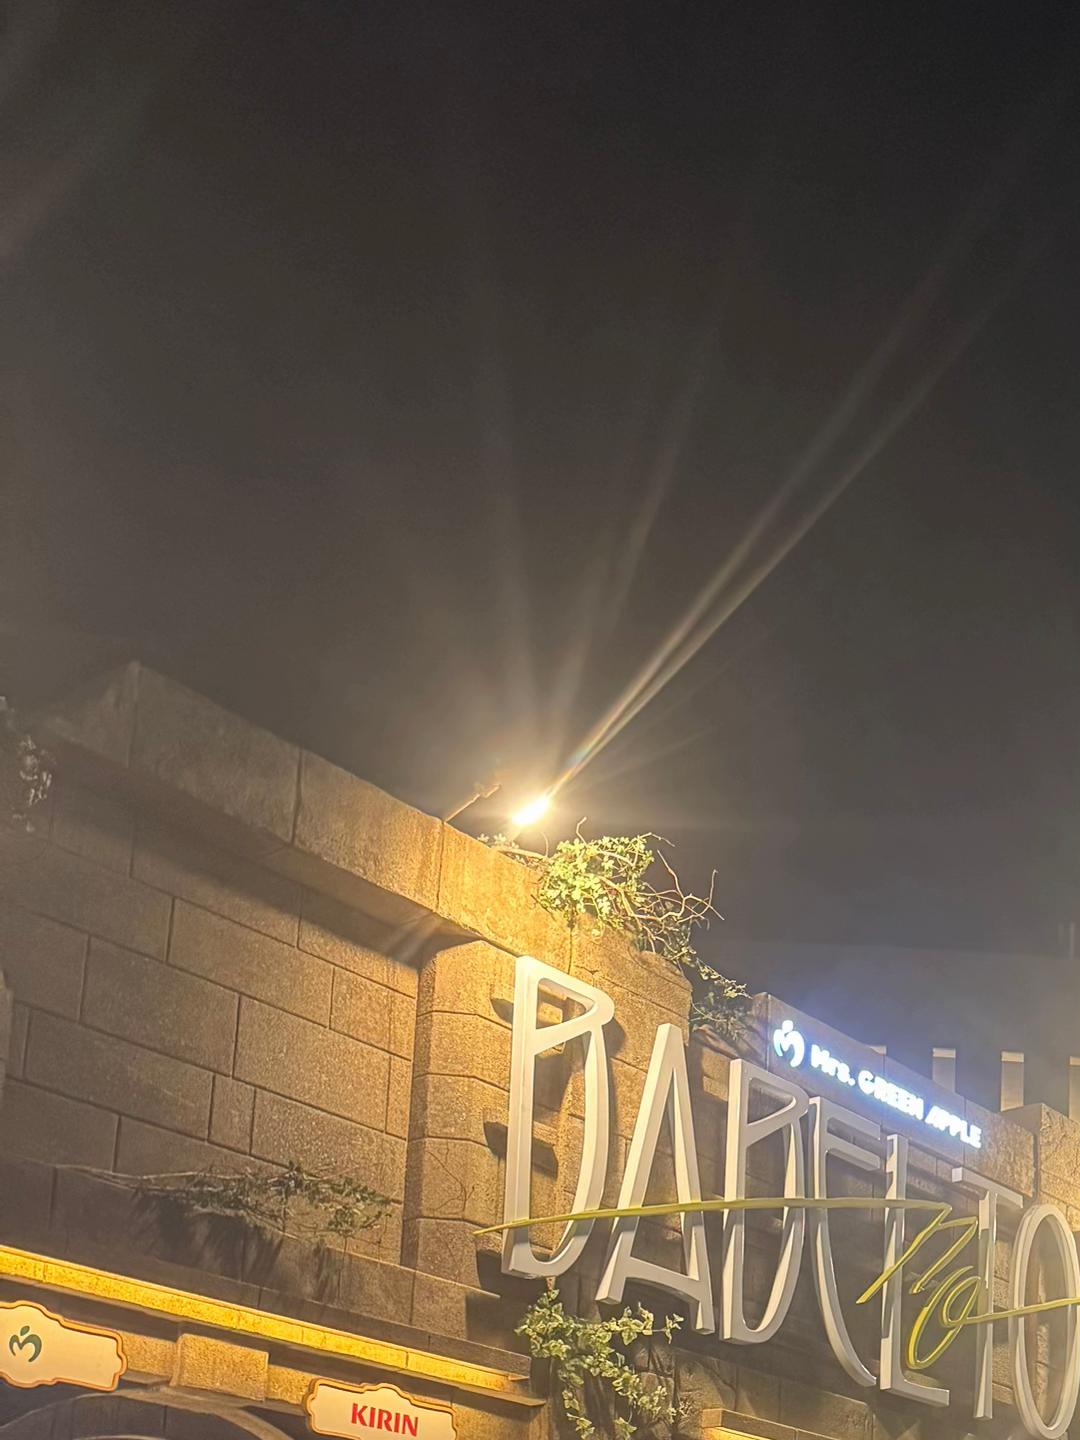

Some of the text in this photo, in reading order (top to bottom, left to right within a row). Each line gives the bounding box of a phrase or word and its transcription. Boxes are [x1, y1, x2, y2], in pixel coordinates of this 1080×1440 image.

[811, 1044, 983, 1149] Mrs. GREEN APPLE
[351, 1402, 419, 1438] KIRIN
